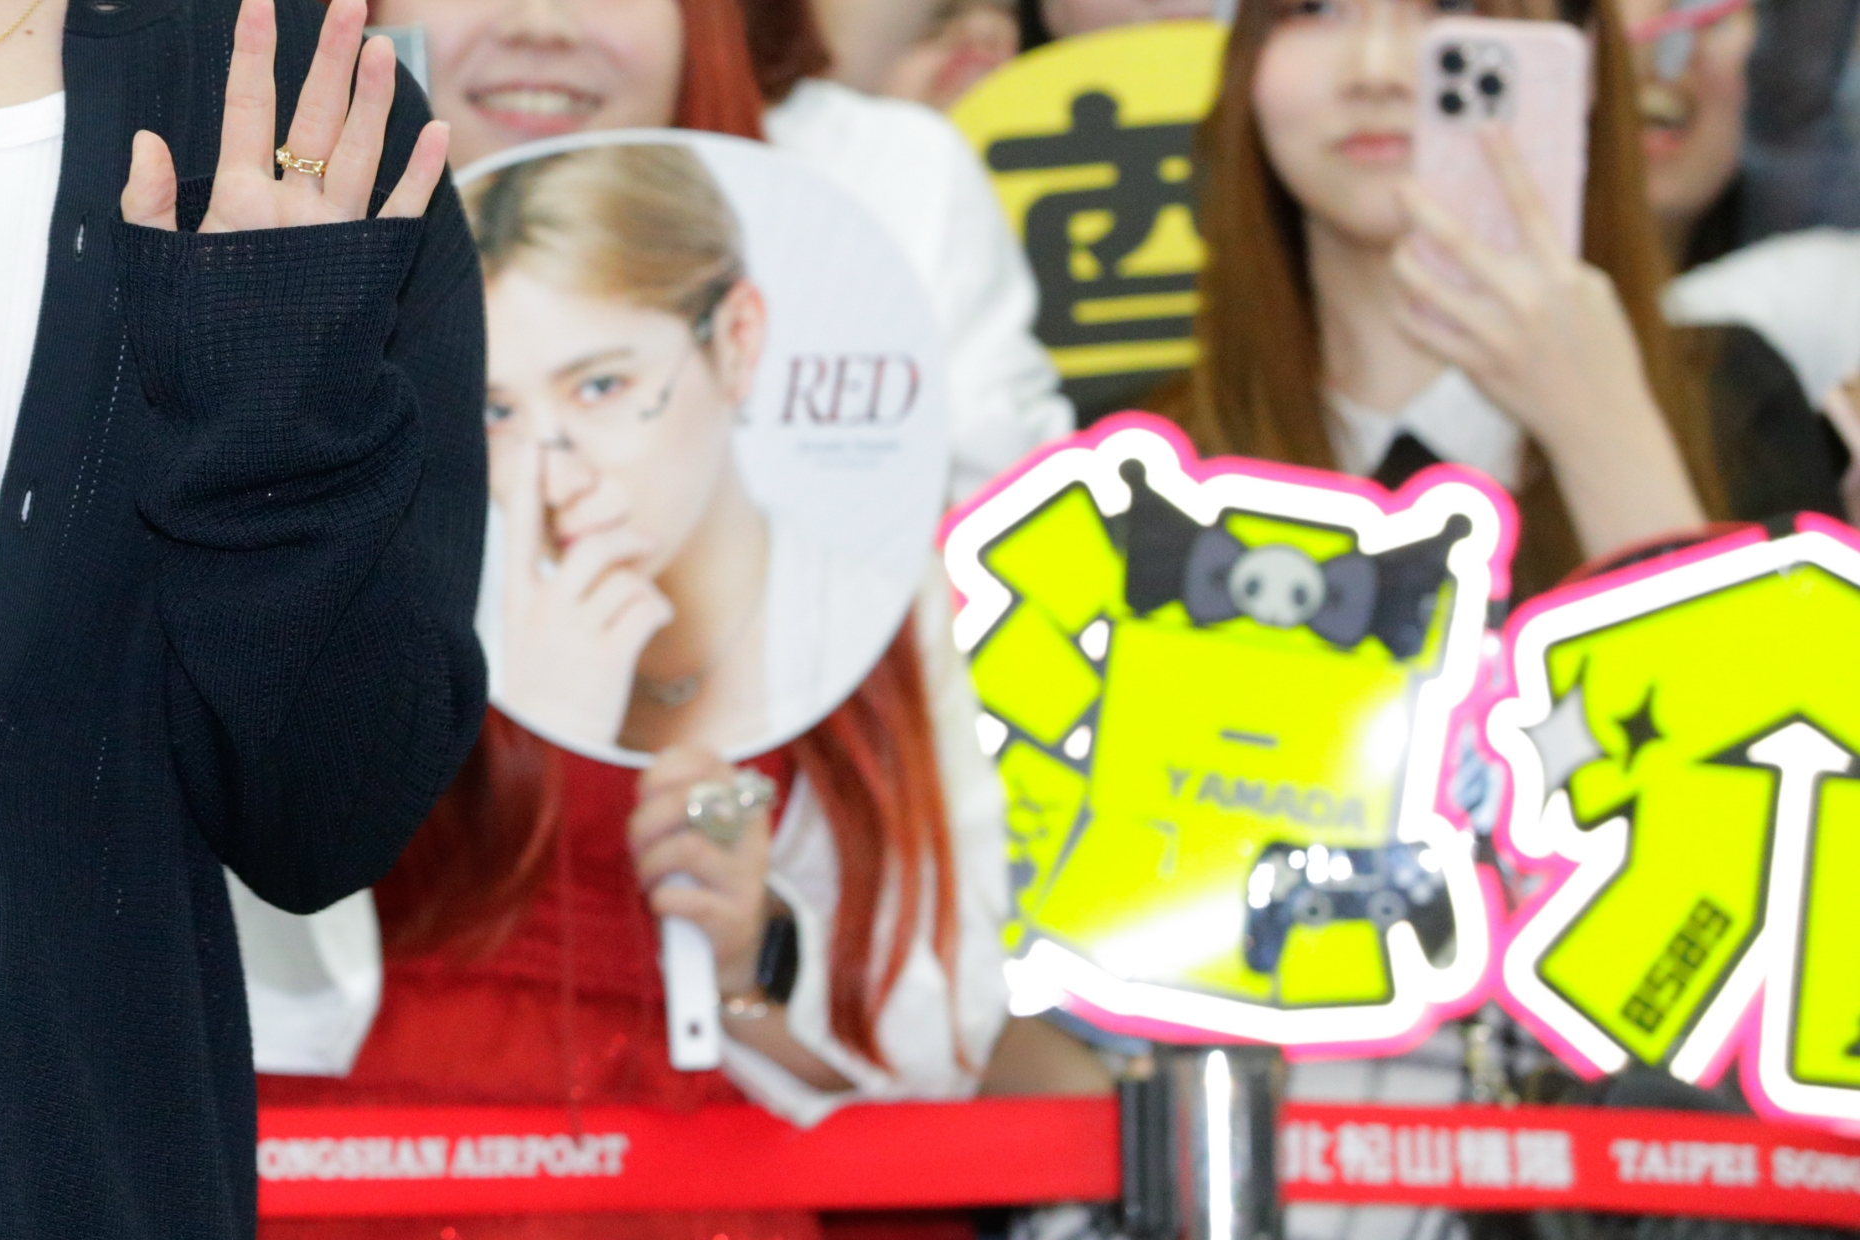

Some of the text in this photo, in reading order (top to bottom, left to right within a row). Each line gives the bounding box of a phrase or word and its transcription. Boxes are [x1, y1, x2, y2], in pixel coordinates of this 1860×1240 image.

[781, 351, 922, 425] RED
[1164, 763, 1370, 832] YAMADA
[256, 1132, 630, 1181] ONGSHAN AIRPORT
[1608, 1137, 1760, 1188] TAIPEI
